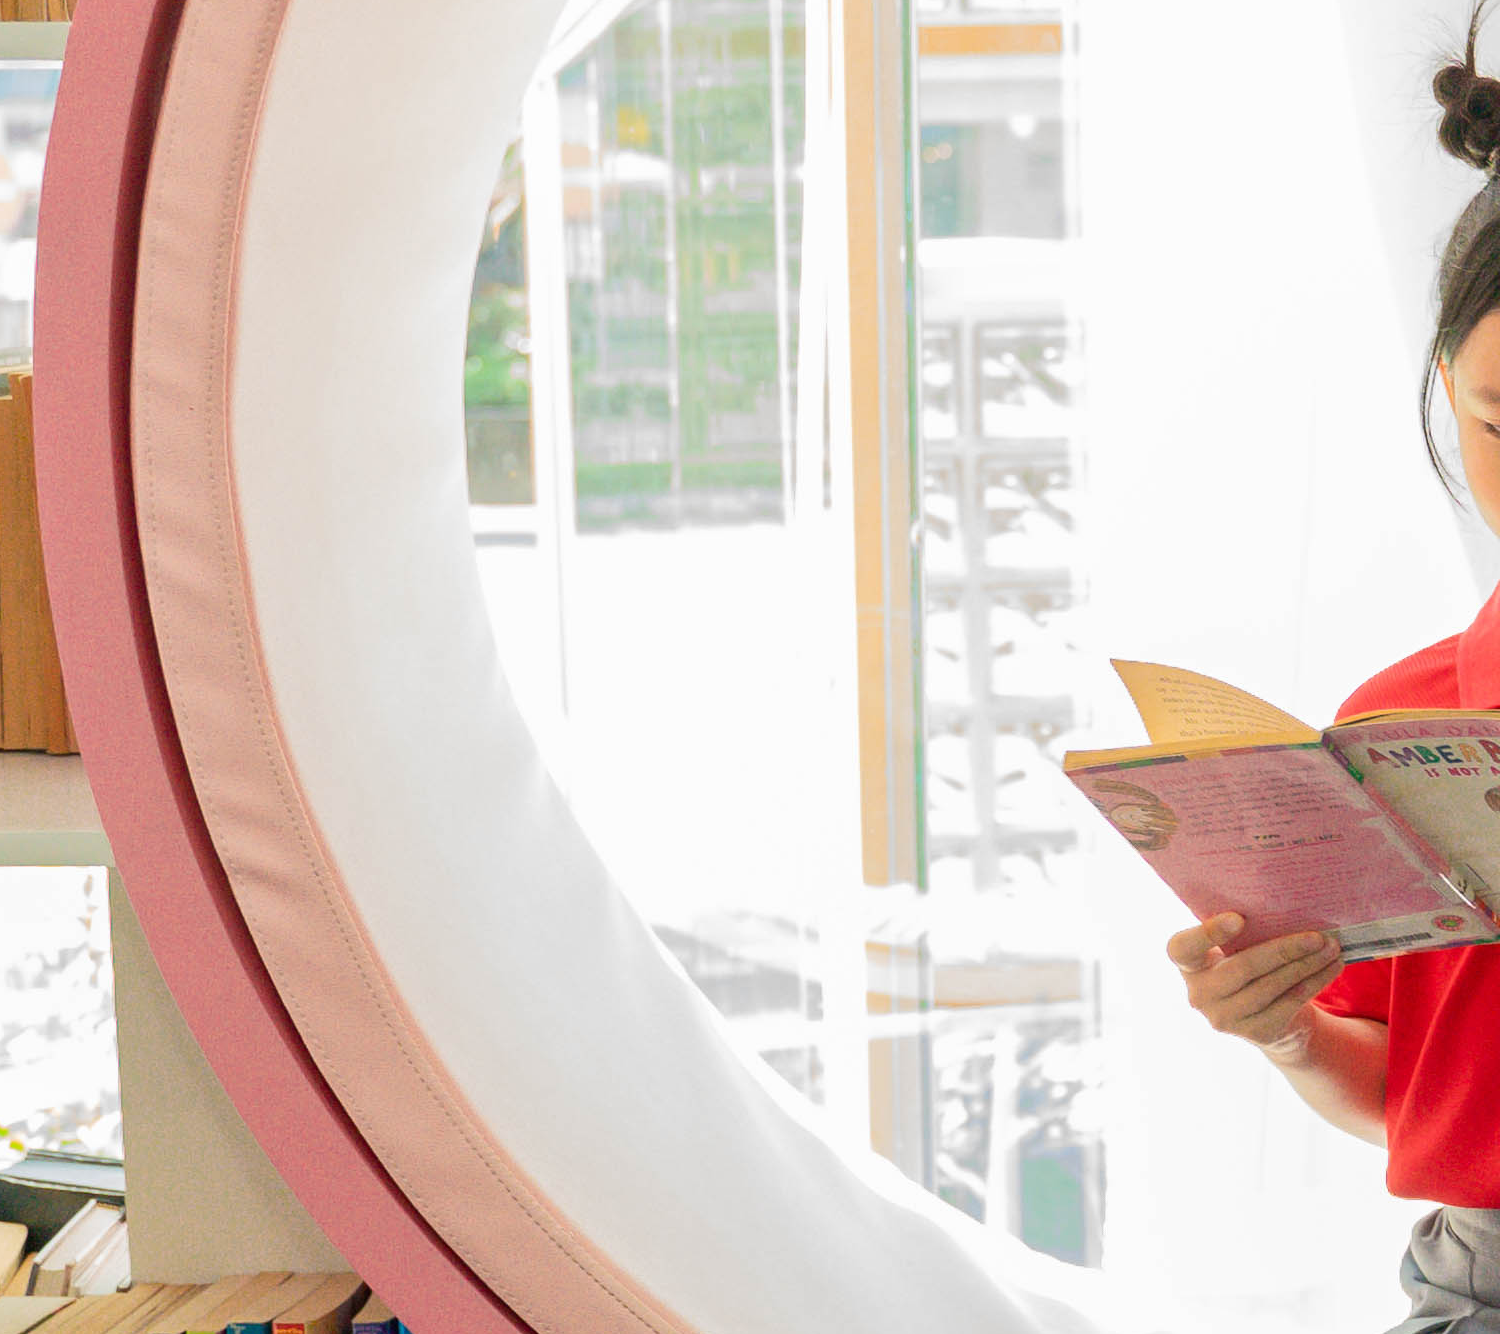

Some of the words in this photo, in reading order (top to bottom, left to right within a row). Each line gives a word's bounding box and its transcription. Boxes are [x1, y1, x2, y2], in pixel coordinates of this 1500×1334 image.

[1366, 742, 1483, 768] AMBER
[1425, 768, 1440, 778] IS
[1450, 767, 1479, 778] NOT
